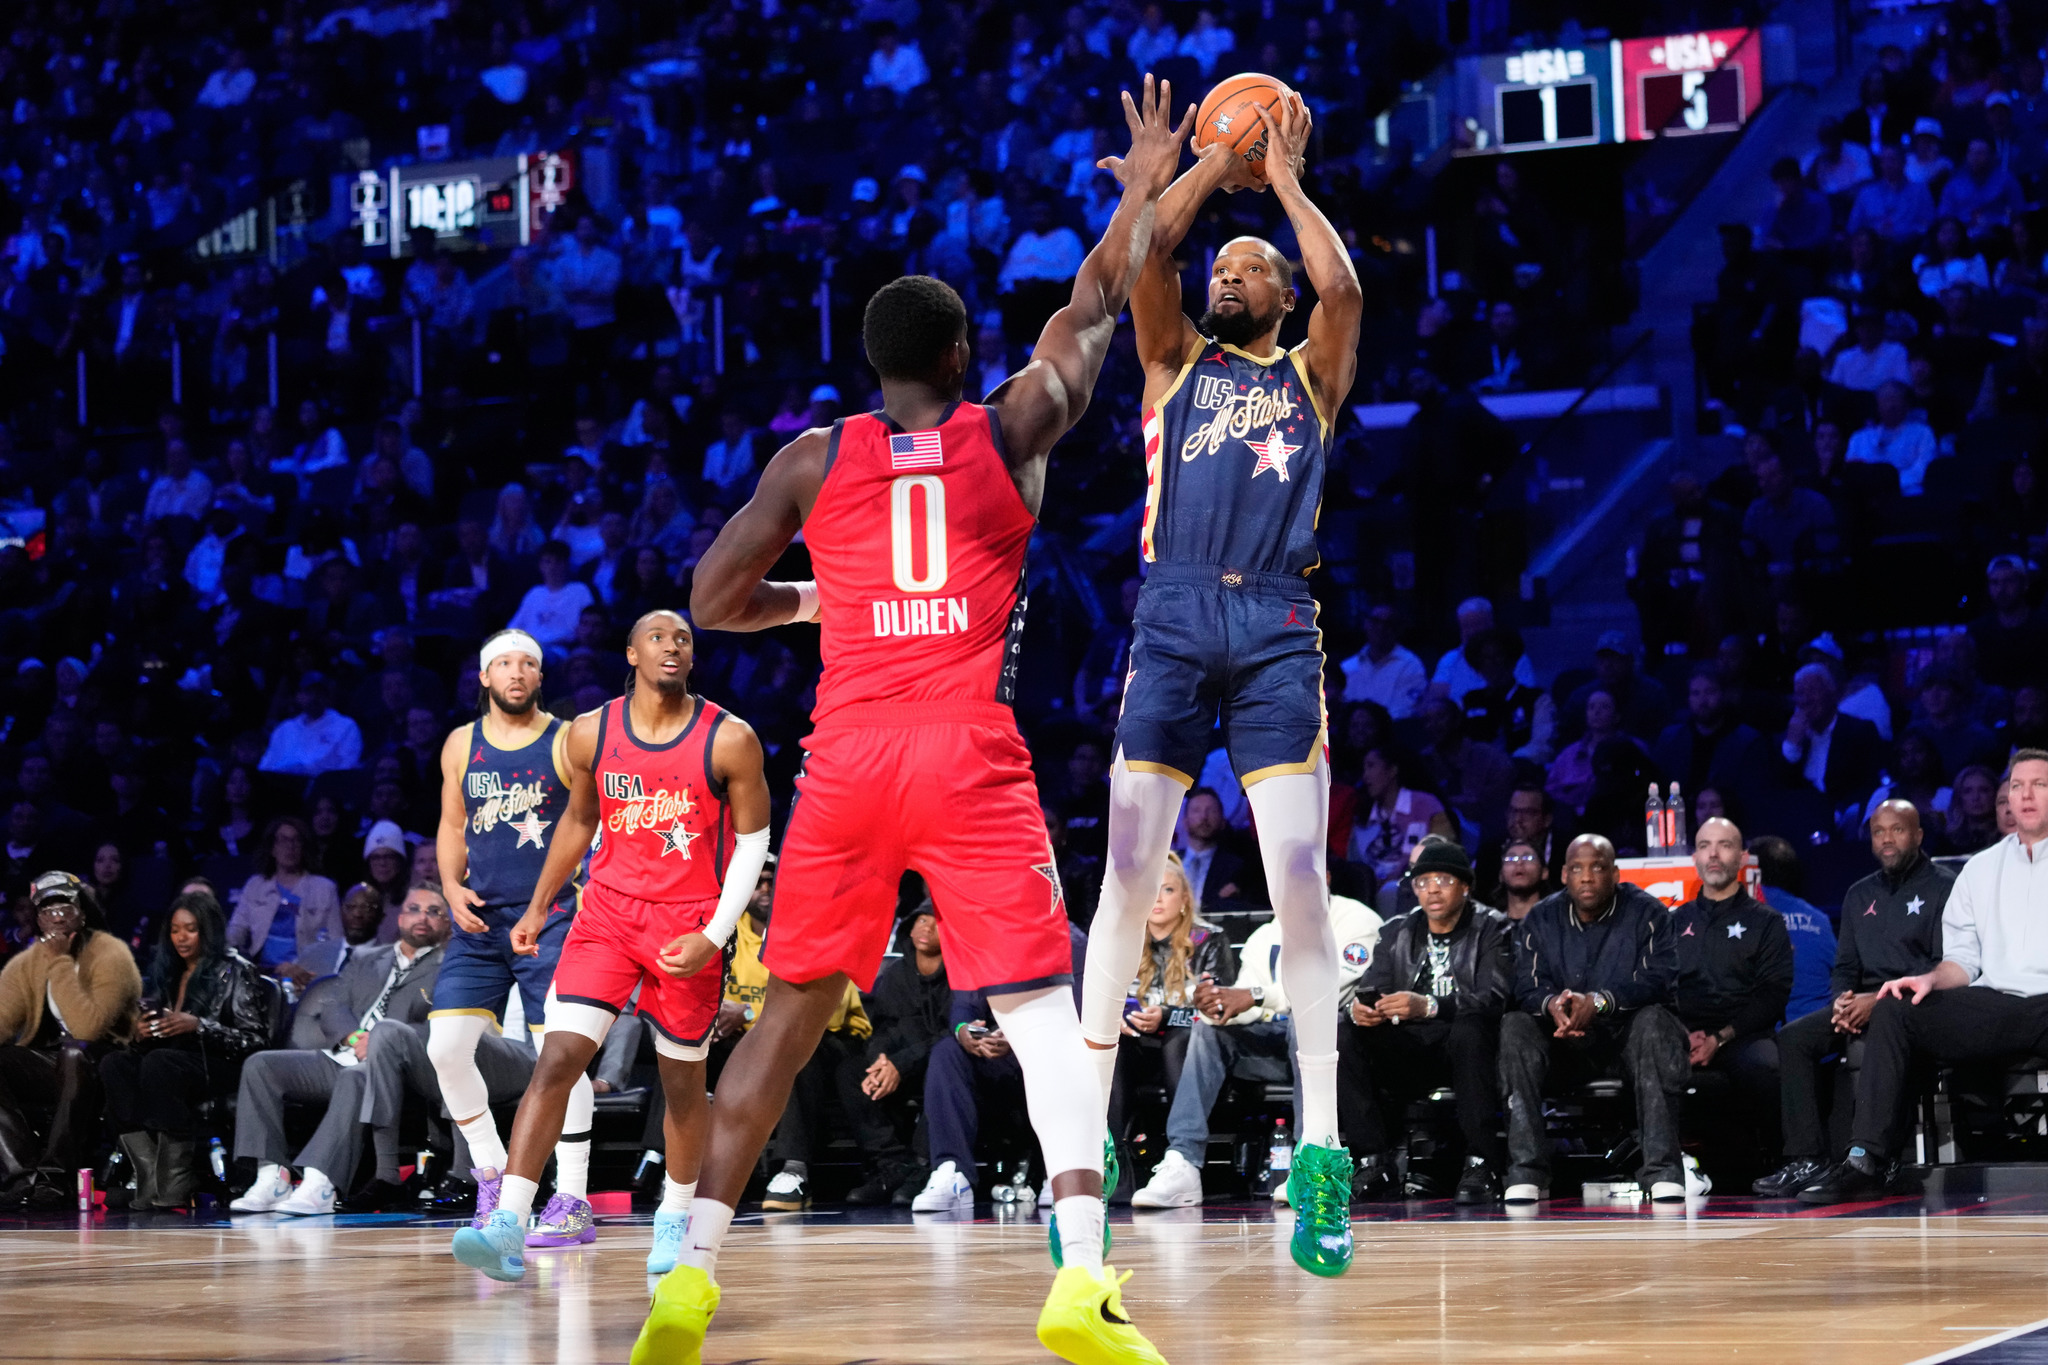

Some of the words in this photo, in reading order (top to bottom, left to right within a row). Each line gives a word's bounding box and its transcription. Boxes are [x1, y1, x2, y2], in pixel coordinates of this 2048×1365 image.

[1522, 48, 1572, 85] USA
[1664, 33, 1715, 71] USA
[1539, 86, 1557, 143] 1
[1682, 70, 1708, 130] 5
[1194, 375, 1235, 410] US
[1181, 404, 1234, 463] All
[1228, 386, 1299, 439] Stars
[890, 474, 948, 593] 0
[872, 597, 968, 637] DUREN
[468, 772, 503, 798] USA
[604, 771, 645, 802] USA
[472, 797, 503, 834] All
[488, 780, 548, 822] Stars
[608, 802, 644, 835] All
[630, 788, 697, 829] Stars
